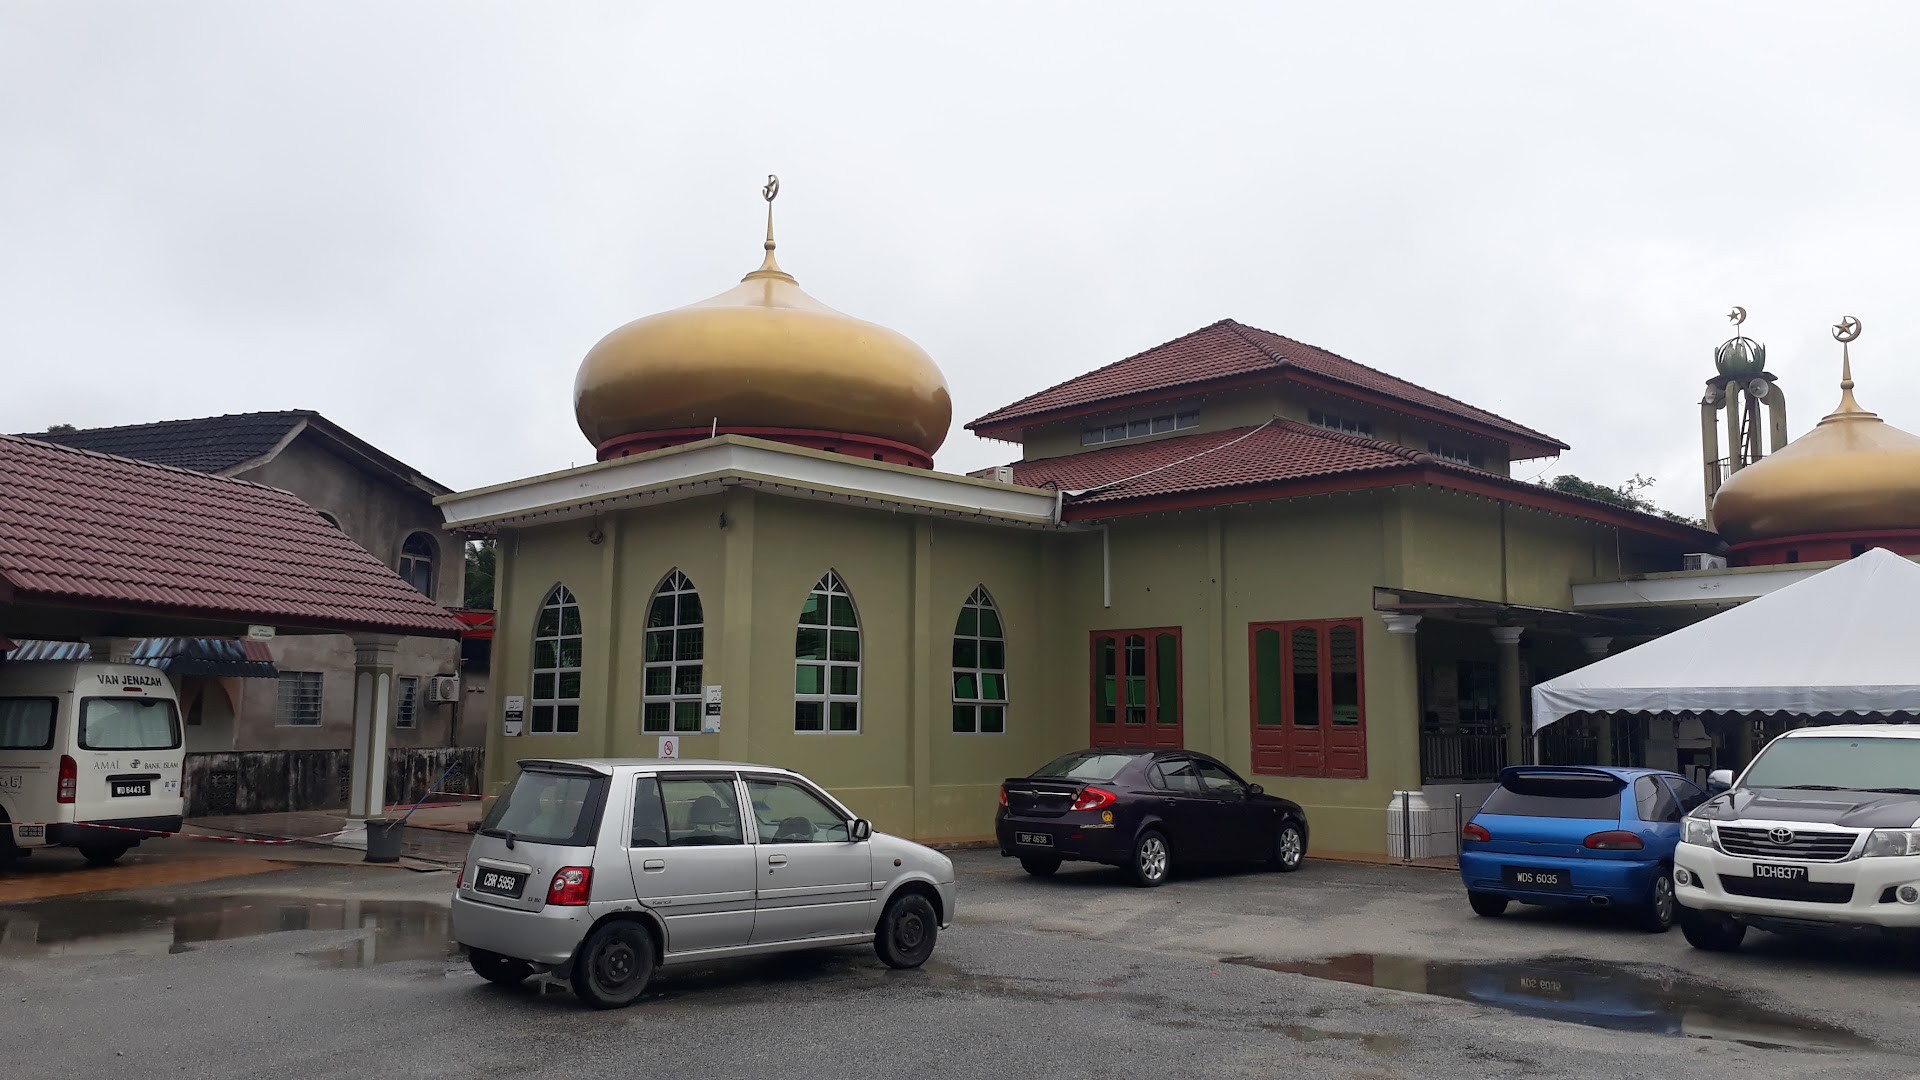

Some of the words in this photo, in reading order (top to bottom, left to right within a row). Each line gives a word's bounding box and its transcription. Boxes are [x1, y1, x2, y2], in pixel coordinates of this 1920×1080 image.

[97, 674, 119, 685] VAN
[122, 675, 162, 687] JENAZAH
[94, 759, 121, 770] AMAL
[144, 762, 161, 770] BANK
[163, 761, 179, 769] ISLAM
[483, 873, 499, 888] CBR
[497, 875, 516, 891] 5959
[1516, 872, 1533, 883] WDS
[1536, 873, 1558, 884] 6035
